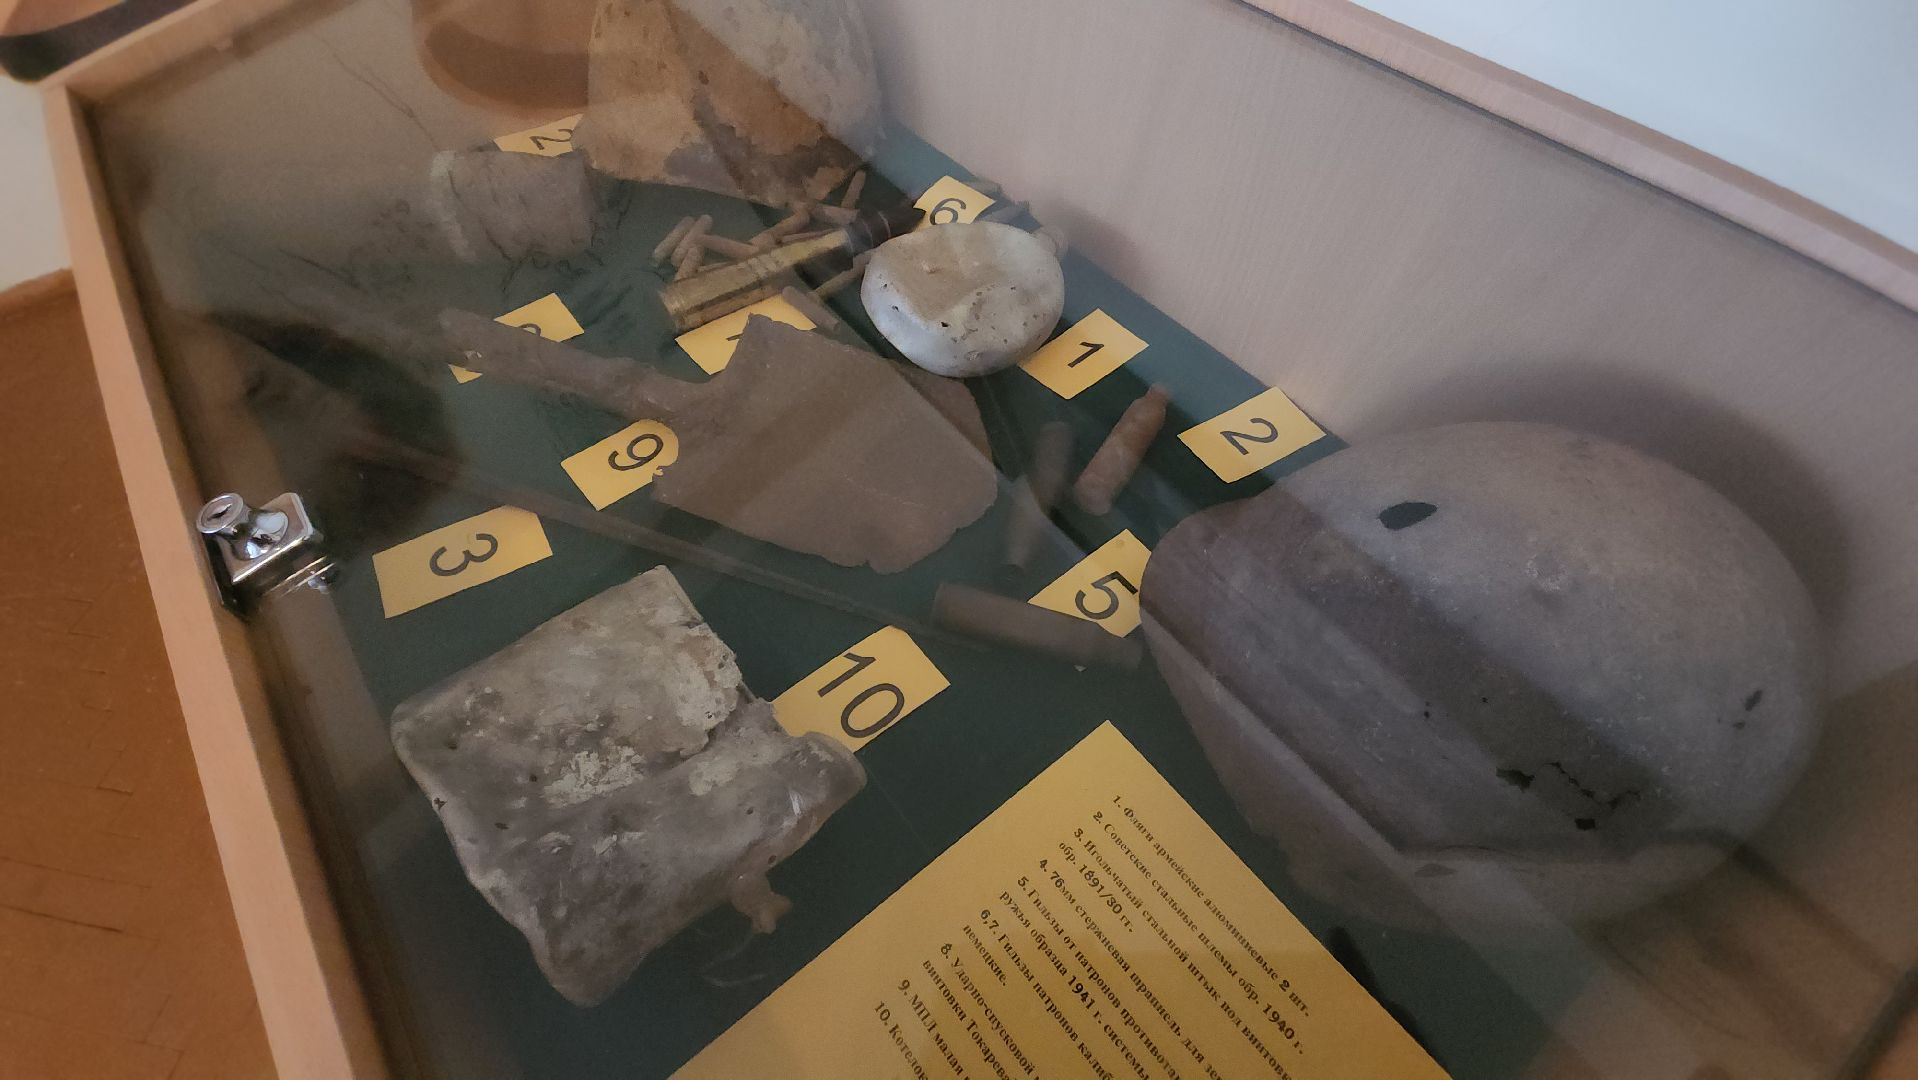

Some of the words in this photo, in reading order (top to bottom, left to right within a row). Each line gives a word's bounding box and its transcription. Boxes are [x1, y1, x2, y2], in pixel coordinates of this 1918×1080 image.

[529, 128, 573, 150] 2
[929, 198, 966, 225] 6
[1067, 341, 1105, 369] 1
[607, 433, 664, 472] 9
[1219, 417, 1279, 456] 2
[429, 533, 499, 577] 3
[1074, 570, 1139, 620] 5
[817, 652, 905, 738] 10
[1058, 842, 1076, 866] обр.
[1078, 863, 1123, 915] 1891/30
[1118, 914, 1134, 933] гг.
[1073, 827, 1084, 843] 3.
[1083, 840, 1144, 910] Игольчатый
[1141, 910, 1190, 963] стальной
[1186, 961, 1221, 1003] штык
[1219, 1000, 1243, 1029] под
[1112, 795, 1122, 809] 1.
[1123, 807, 1155, 843] Фляги
[1152, 842, 1205, 899] армейские
[1278, 979, 1291, 993] 2
[1288, 991, 1310, 1018] шт.
[962, 924, 1007, 987] немецкие.
[980, 909, 1000, 936] 6,7.
[997, 933, 1035, 983] Гильзы
[1032, 982, 1079, 1042] патронов
[998, 891, 1031, 929] ружья
[1030, 928, 1068, 977] образца
[1067, 975, 1096, 1011] 1941
[1092, 1010, 1103, 1025] г.
[1017, 875, 1030, 892] 5.
[1026, 888, 1065, 937] Гильзы
[1063, 935, 1078, 951] от
[1074, 950, 1121, 1009] патронов
[1039, 859, 1048, 873] 4.
[1049, 870, 1077, 906] 76мм
[1074, 905, 1131, 973] стержневая
[1129, 972, 1181, 1038] шрапнель
[1180, 1037, 1205, 1065] для
[1092, 810, 1104, 825] 2.
[1103, 823, 1152, 880] Советские
[1151, 879, 1198, 933] стальные
[1197, 932, 1239, 979] шлемы
[1238, 977, 1260, 1005] обр.
[1262, 1002, 1296, 1040] 1940
[1293, 1040, 1304, 1055] г.
[874, 1000, 891, 1027] 10.
[897, 979, 911, 997] 9.
[908, 993, 938, 1034] МПЛ
[932, 1032, 964, 1077] малая
[922, 959, 967, 1023] винтовки
[940, 943, 953, 960] 8.
[950, 956, 1036, 1077] Ударно-спусковой
